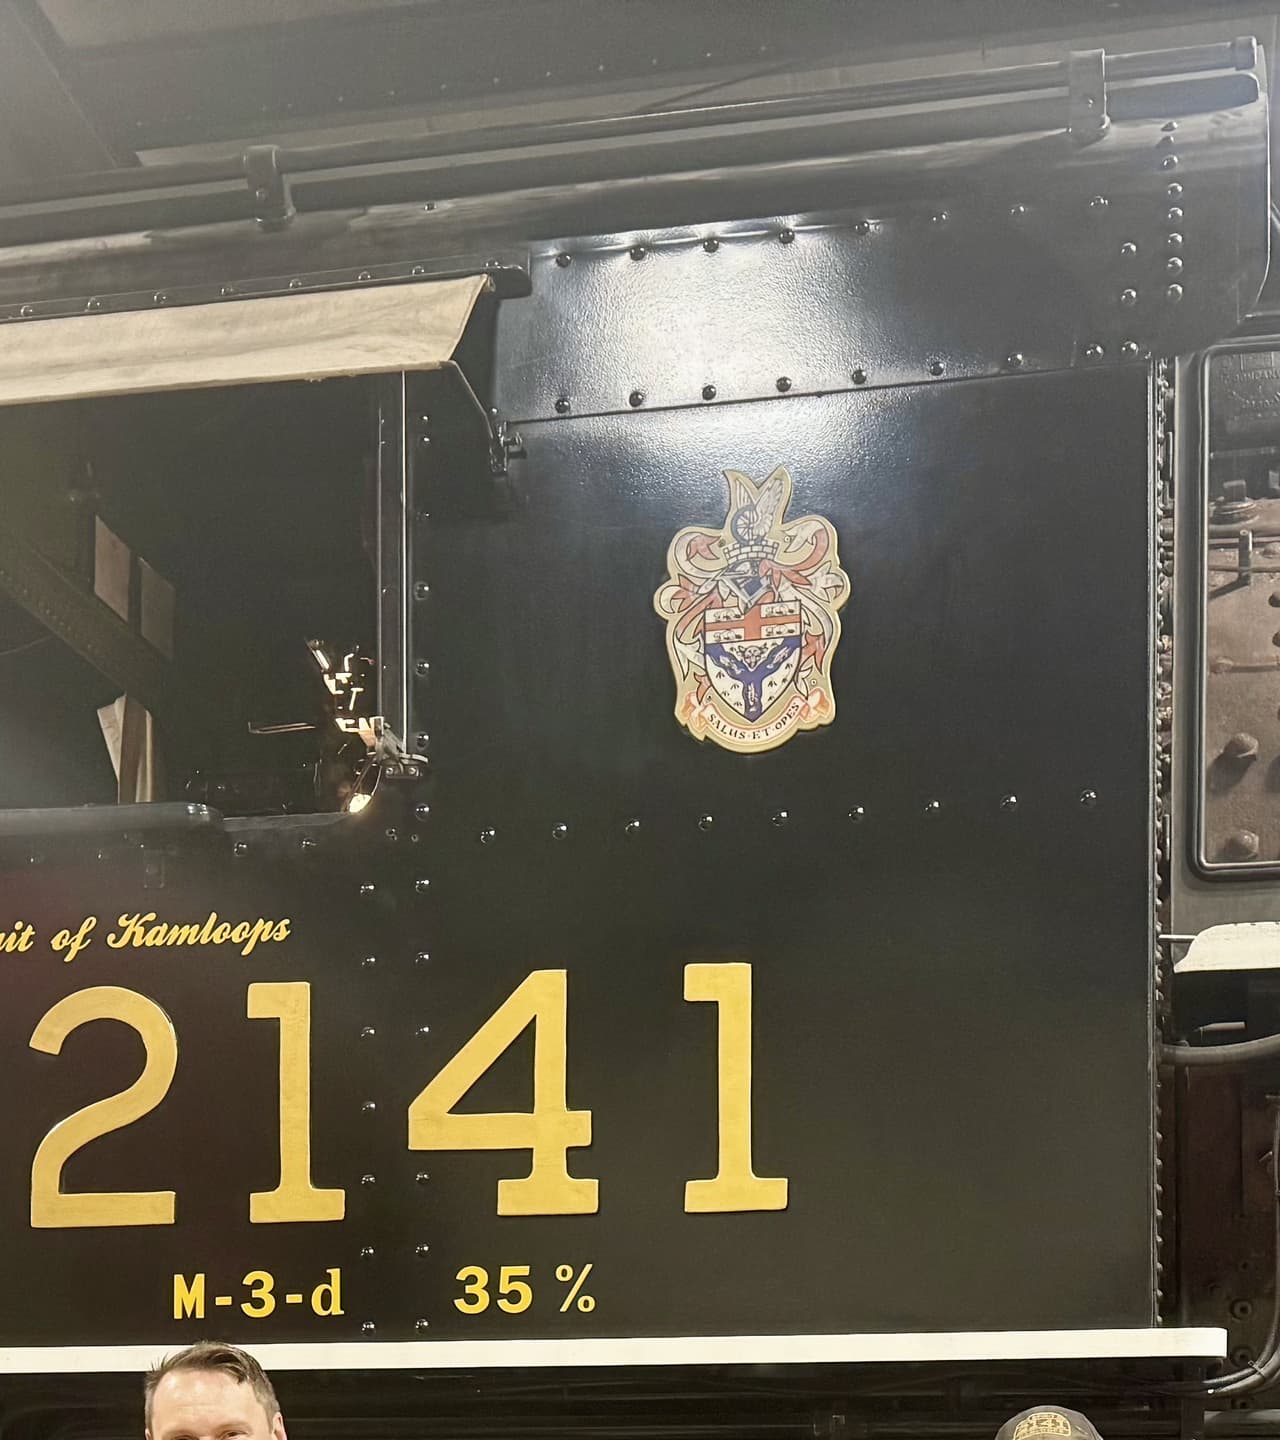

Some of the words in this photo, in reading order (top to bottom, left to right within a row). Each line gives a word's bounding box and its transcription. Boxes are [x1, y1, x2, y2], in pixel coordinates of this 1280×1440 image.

[707, 713, 747, 740] SALUS
[752, 726, 771, 740] ET
[775, 702, 800, 730] OPES
[49, 915, 98, 963] of
[106, 911, 292, 957] Kamloops
[29, 961, 789, 1228] 2141
[172, 1266, 346, 1321] M-3-d
[454, 1263, 534, 1315] 35
[553, 1263, 597, 1315] %
